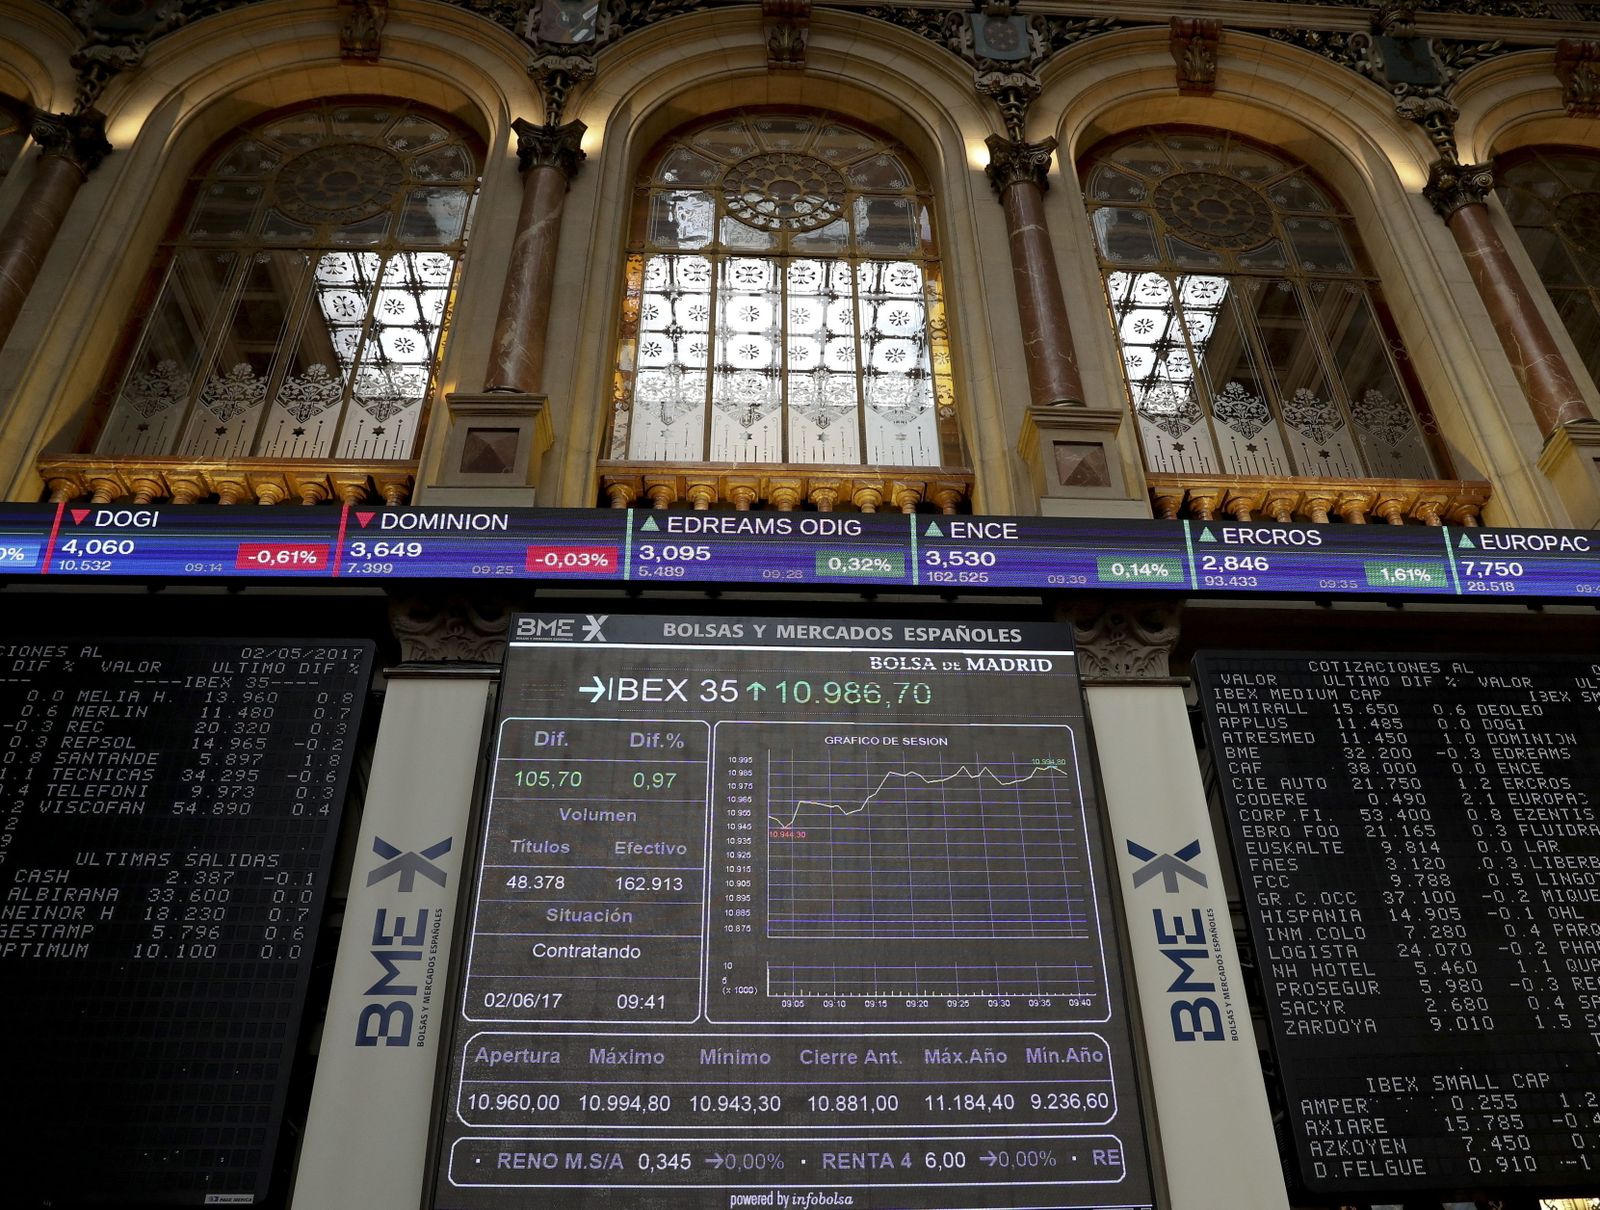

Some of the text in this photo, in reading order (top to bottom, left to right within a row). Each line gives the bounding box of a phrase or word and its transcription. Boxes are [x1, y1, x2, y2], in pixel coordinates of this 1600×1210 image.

[95, 511, 158, 527] DOGI
[381, 513, 508, 530] DOMINION
[668, 517, 861, 535] EDREAMS ODIG
[951, 522, 1018, 539] ENCE
[1223, 528, 1321, 545] ERCROS
[62, 540, 136, 556] 4,060
[1480, 535, 1589, 551] EUROPAC
[351, 543, 422, 559] 3,649
[640, 545, 710, 563] 3,095
[58, 560, 111, 571] 10.532
[248, 551, 318, 567] -0,61%
[536, 552, 608, 569] -0,03%
[829, 558, 891, 572] 0,32%
[926, 551, 995, 568] 3,530
[1201, 556, 1269, 572] 2,846
[346, 563, 393, 573] 7.399
[639, 566, 684, 576] 5.489
[1112, 563, 1168, 579] 0,14%
[1462, 562, 1523, 578] 7,750
[927, 572, 988, 582] 162.525
[1205, 576, 1257, 586] 93.433
[1380, 568, 1432, 583] 1,61%
[1468, 582, 1516, 591] 28.518
[517, 619, 574, 636] BME
[664, 623, 1021, 642] BOLSAS Y MERCADOS ESPAÑOLES
[241, 648, 362, 659] 02/05/2017
[213, 663, 285, 673] ULTIMO
[870, 657, 1052, 671] BOLSA DE MADRID
[1309, 661, 1440, 673] COTIZACIONES
[1221, 674, 1277, 685] VALOR
[1323, 675, 1389, 686] ULTIMO
[78, 691, 140, 702] MELIA
[609, 678, 738, 702] IBEX 35
[776, 681, 930, 705] 10.986,70
[1214, 689, 1381, 700] IBEX MEDIUM CAP
[205, 692, 278, 703] 13.960
[72, 706, 148, 717] MERLIN
[1216, 703, 1307, 714] ALMIRALL
[1333, 704, 1398, 714] 15.650
[1477, 705, 1543, 715] DEOLEO
[67, 721, 104, 732] REC
[1219, 717, 1287, 728] APPLUS
[61, 737, 135, 748] REPSOL
[535, 731, 567, 746] Dif.
[630, 733, 684, 748] Dif.%
[883, 737, 898, 745] DE
[1223, 732, 1314, 743] ATRESMED
[56, 752, 159, 764] SANTANDE
[1344, 748, 1411, 758] 32.200
[1492, 748, 1570, 759] EDREAMS
[53, 768, 154, 781] TECNICAS
[1229, 762, 1261, 773] CAF
[516, 771, 581, 787] 105,70
[634, 773, 676, 790] 0,97
[1232, 778, 1327, 789] CIE AUTO
[1503, 778, 1571, 789] ERCROS
[48, 784, 148, 797] TELEFONI
[1236, 794, 1307, 805] CODERE
[40, 801, 145, 814] VISCOFAN
[173, 802, 250, 815] 54.890
[560, 808, 636, 821] Volumen
[1513, 808, 1594, 820] EZENTIS
[1242, 826, 1339, 837] EBRO FOO
[511, 839, 569, 853] Títulos
[615, 842, 687, 854] Efectivo
[1246, 842, 1344, 854] EUSKALTE
[76, 853, 279, 867] ULTIMAS SALIDAS
[1250, 859, 1298, 871] FAES
[15, 870, 69, 883] CASH
[507, 876, 564, 889] 48.378
[616, 877, 682, 890] 162.913
[1253, 876, 1289, 888] FCC
[8, 888, 119, 901] ALBIRANA
[145, 907, 225, 920] 18.230
[547, 908, 632, 922] Situación
[1261, 909, 1361, 923] HISPANIA
[1390, 908, 1461, 921] 14.905
[1207, 908, 1222, 951] ESPAÑOLES
[134, 944, 216, 958] 10.100
[533, 944, 640, 958] Contratando
[1269, 945, 1358, 959] LOGISTA
[355, 908, 428, 1046] BME
[417, 1014, 428, 1047] BOLSAS
[423, 956, 436, 1004] MERCADOS
[430, 908, 442, 953] ESPAÑOLES
[1152, 909, 1225, 1041] BME
[1217, 954, 1230, 1001] MERCADOS
[1276, 981, 1380, 996] PROSEGUR
[485, 993, 562, 1008] 02/06/17
[618, 995, 664, 1009] 09:41
[1228, 1009, 1239, 1041] BOLSAS
[1284, 1019, 1376, 1034] ZARDOYA
[475, 1047, 560, 1066] Apertura
[590, 1048, 664, 1064] Máximo
[701, 1048, 770, 1064] Mínimo
[800, 1050, 902, 1064] Cierre Ant.
[925, 1048, 1007, 1063] Máx.Año
[1026, 1047, 1103, 1063] Mín.Año
[1367, 1073, 1549, 1092] IBEX SMALL CAP
[469, 1094, 559, 1111] 10.960,00
[580, 1095, 670, 1112] 10.994,80
[691, 1096, 780, 1113] 10.943,30
[809, 1096, 898, 1112] 10.881,00
[926, 1094, 1014, 1111] 11.184,40
[1031, 1093, 1108, 1110] 9.236,60
[1305, 1119, 1387, 1135] AXIARE
[1445, 1115, 1523, 1131] 15.785
[1310, 1139, 1406, 1156] AZKOYEN
[498, 1153, 558, 1168] RENO
[639, 1154, 691, 1173] 0,345
[823, 1153, 911, 1169] RENTA 4
[926, 1152, 965, 1169] 6,00
[1314, 1159, 1426, 1177] D.FELGUE
[730, 1191, 853, 1209] powered by infobolsa
